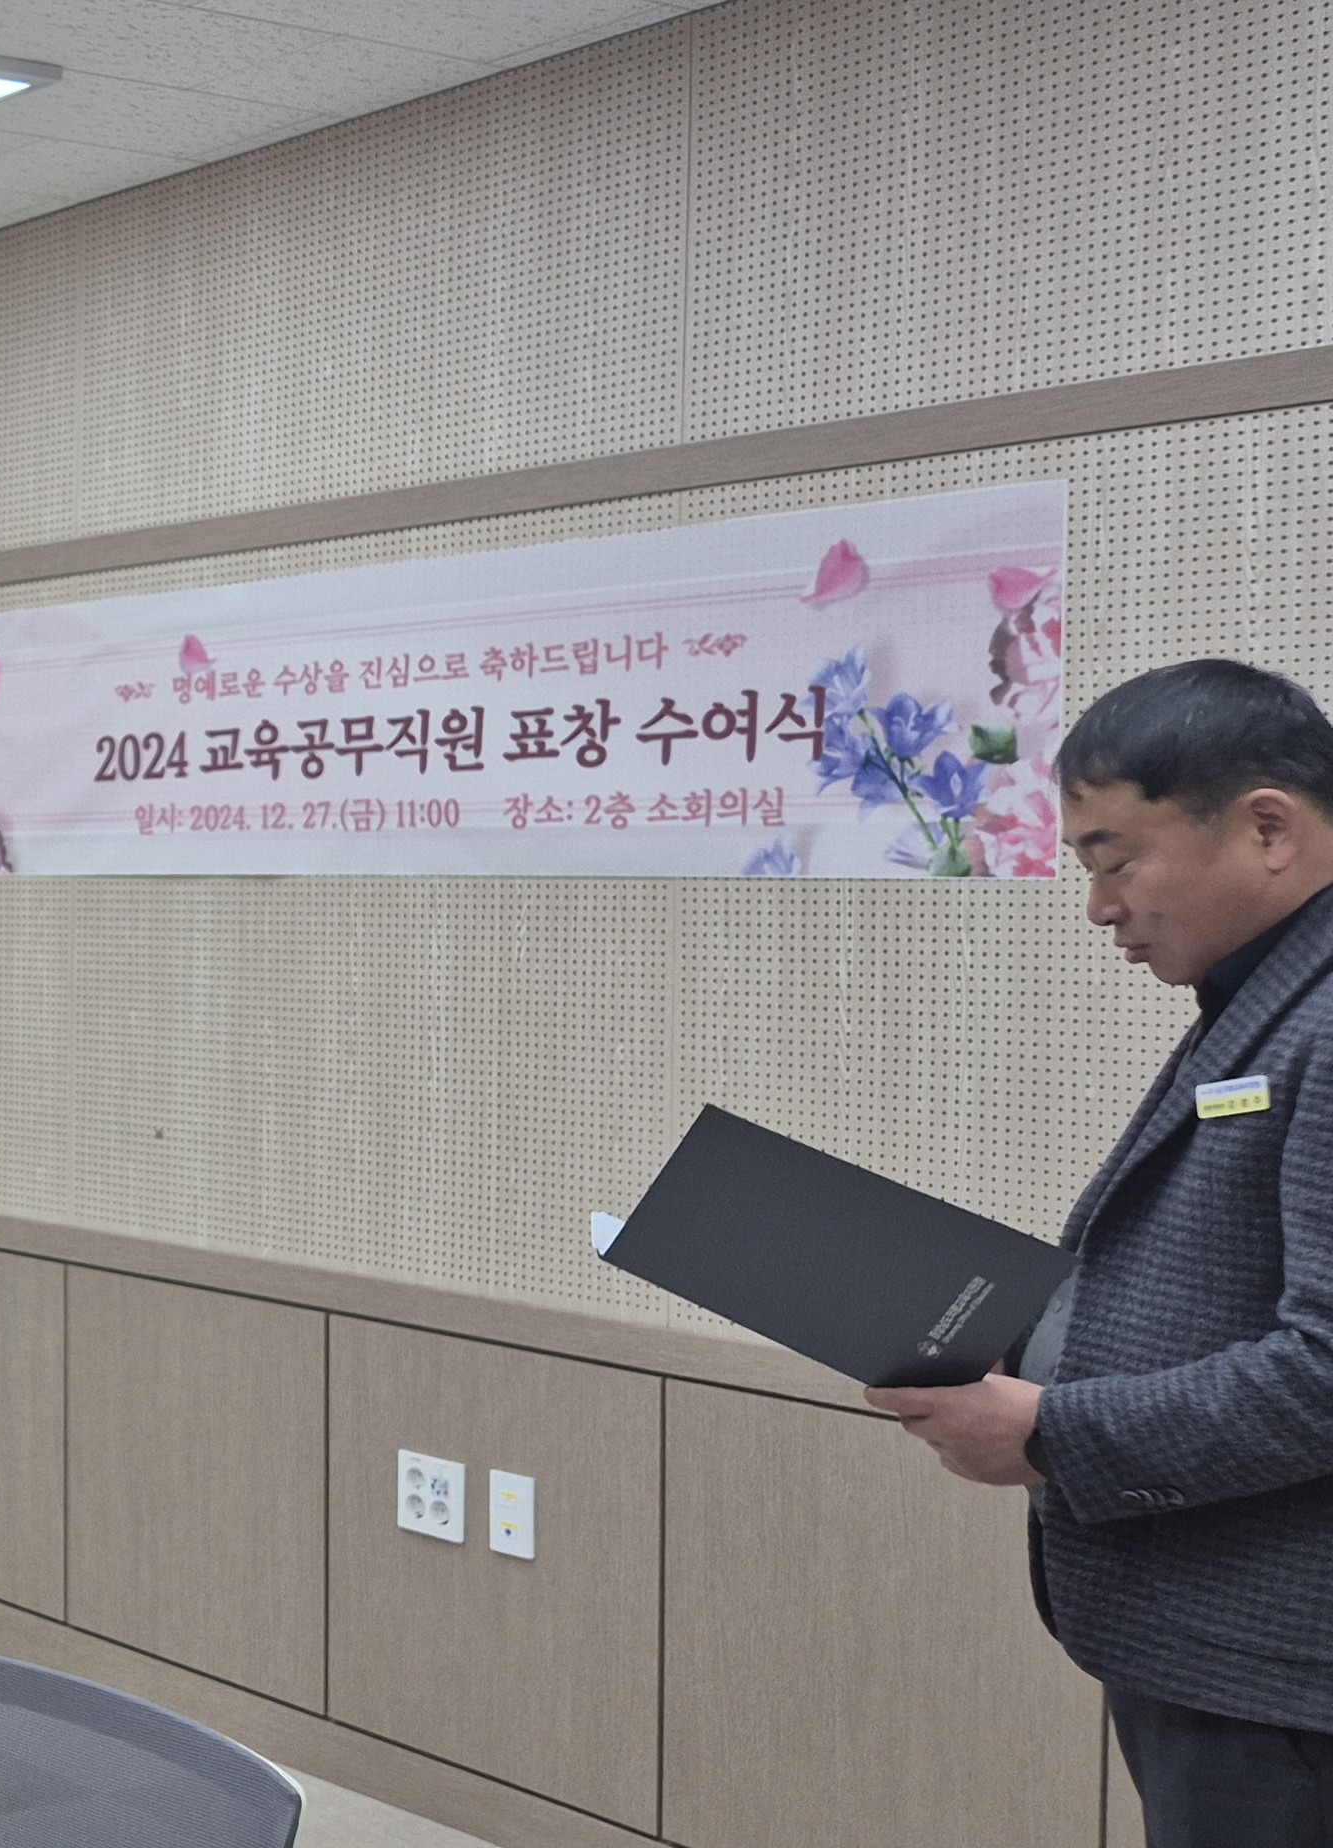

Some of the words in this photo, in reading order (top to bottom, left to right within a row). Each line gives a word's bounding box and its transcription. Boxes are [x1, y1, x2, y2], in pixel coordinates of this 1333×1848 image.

[172, 667, 266, 704] 명예로운
[273, 658, 350, 696] 수상을
[358, 652, 470, 690] 진심으로
[479, 630, 669, 683] 축하드립니다
[94, 730, 189, 782] 2024
[199, 705, 485, 781] 교육공무직원
[502, 697, 622, 769] 표창
[635, 684, 827, 767] 수여식
[134, 802, 183, 836] 일시:
[189, 803, 251, 832] 2024.
[260, 801, 294, 831] 12.
[302, 797, 387, 833] 27.(금)
[395, 797, 460, 829] 11:00
[503, 792, 574, 830] 장소:
[583, 790, 636, 830] 2층
[646, 786, 786, 829] 소회의실
